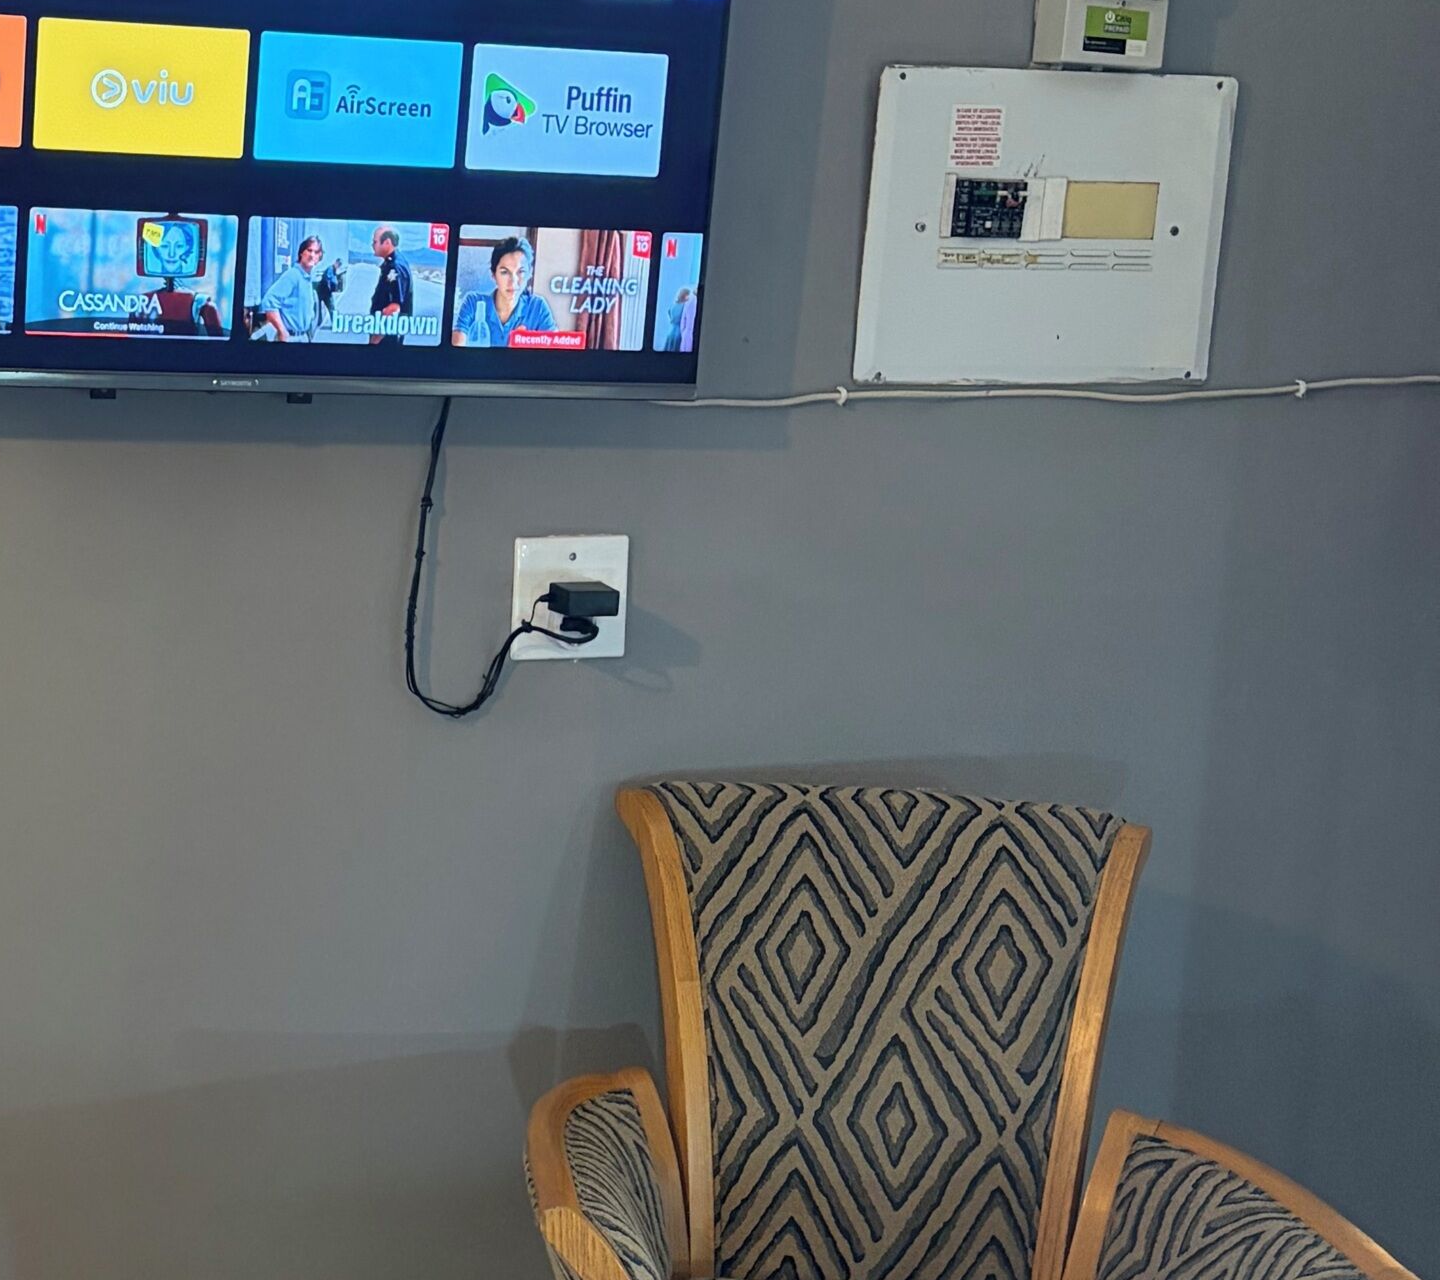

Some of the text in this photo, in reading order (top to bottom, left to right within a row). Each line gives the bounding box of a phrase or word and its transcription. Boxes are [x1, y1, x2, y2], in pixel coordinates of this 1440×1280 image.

[132, 70, 194, 106] viu
[335, 94, 433, 118] AirScreen
[566, 85, 632, 114] Puffin
[542, 114, 655, 139] TV Browser
[432, 227, 447, 235] TOP
[432, 234, 446, 245] 10
[635, 241, 649, 252] 10
[587, 265, 605, 277] THE
[550, 276, 638, 296] CLEANING
[59, 290, 163, 315] CASSANDRA
[569, 296, 616, 314] LADY
[93, 321, 165, 334] Continue Watching
[330, 311, 439, 337] breakdown
[514, 334, 581, 346] Recently Added
